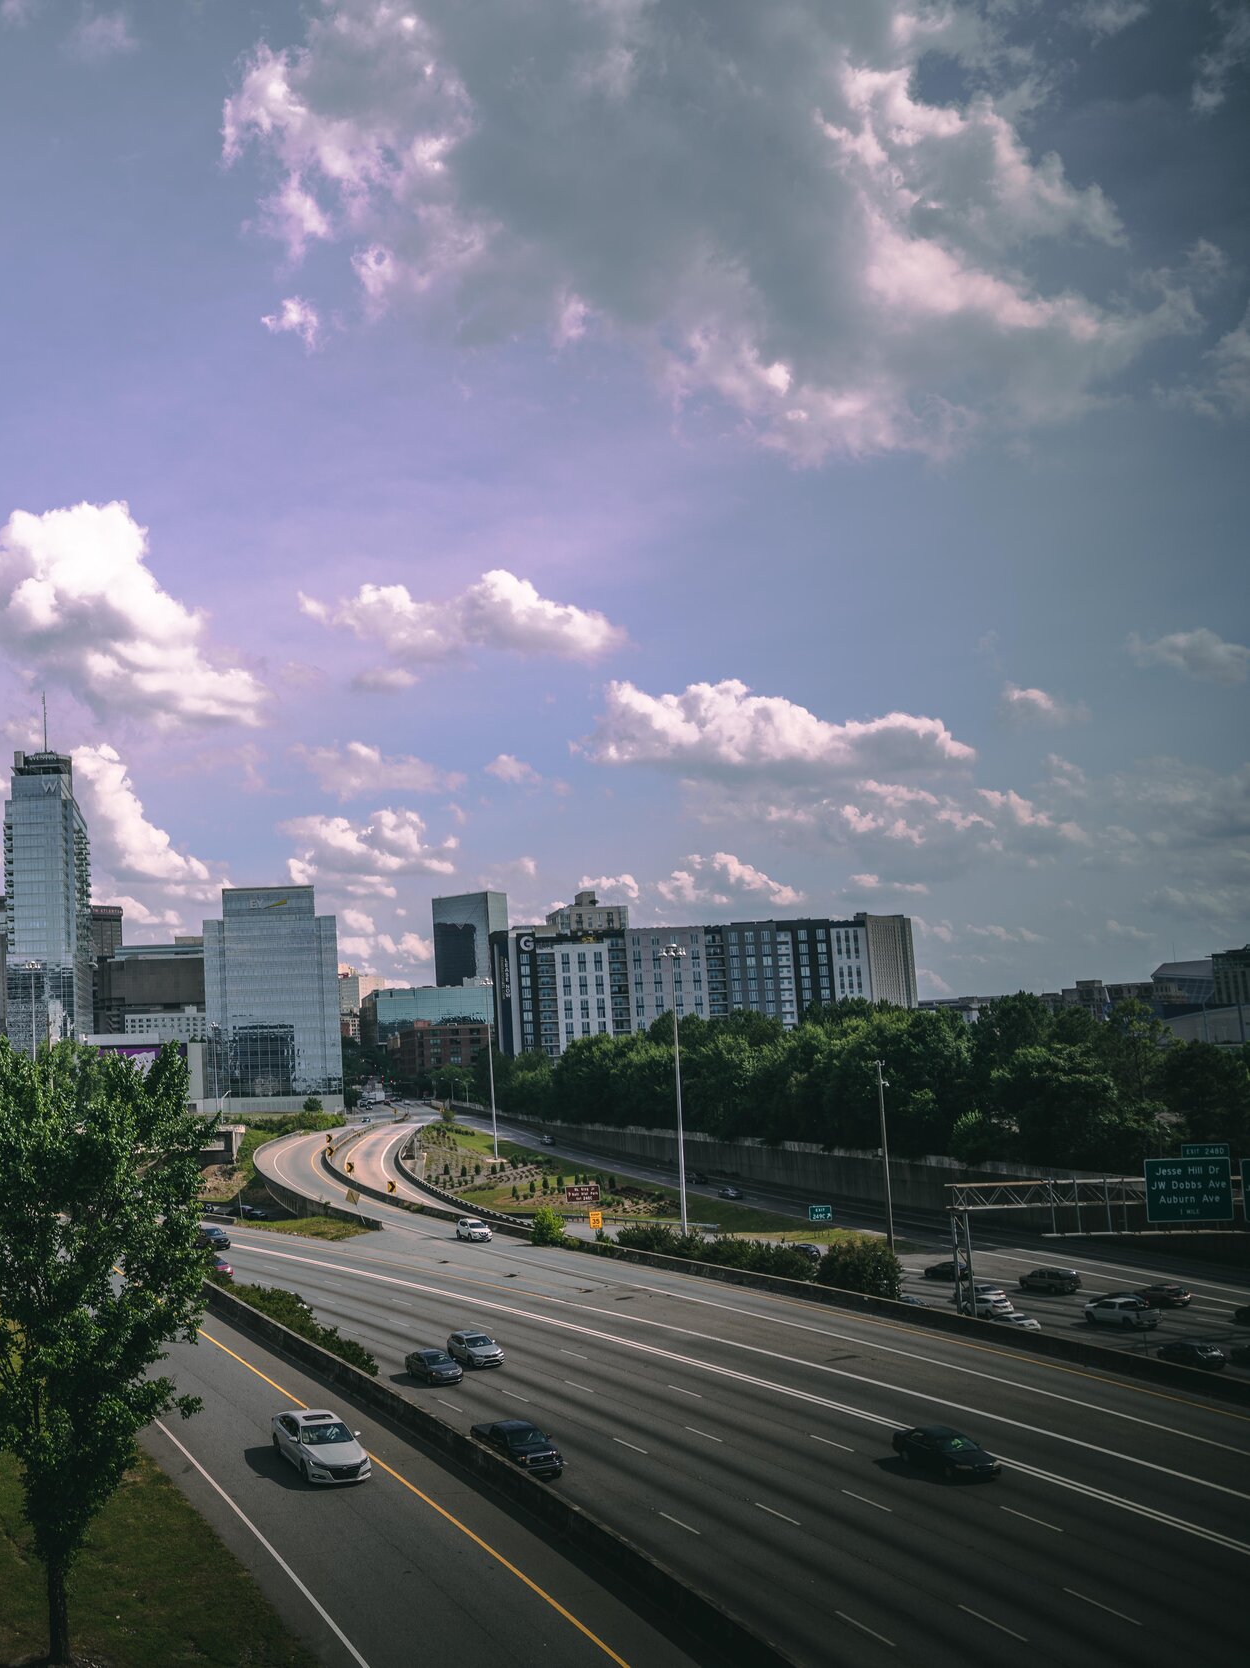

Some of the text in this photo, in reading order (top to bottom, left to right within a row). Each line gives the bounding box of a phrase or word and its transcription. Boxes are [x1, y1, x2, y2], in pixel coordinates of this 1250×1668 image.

[41, 778, 59, 793] W
[250, 899, 264, 909] EY
[519, 936, 535, 951] G
[1205, 1147, 1225, 1155] 248D
[1155, 1165, 1220, 1176] Jesse Hill Dr
[1151, 1180, 1227, 1190] JW Dobbs Ave
[1159, 1194, 1221, 1204] Auburn Ave
